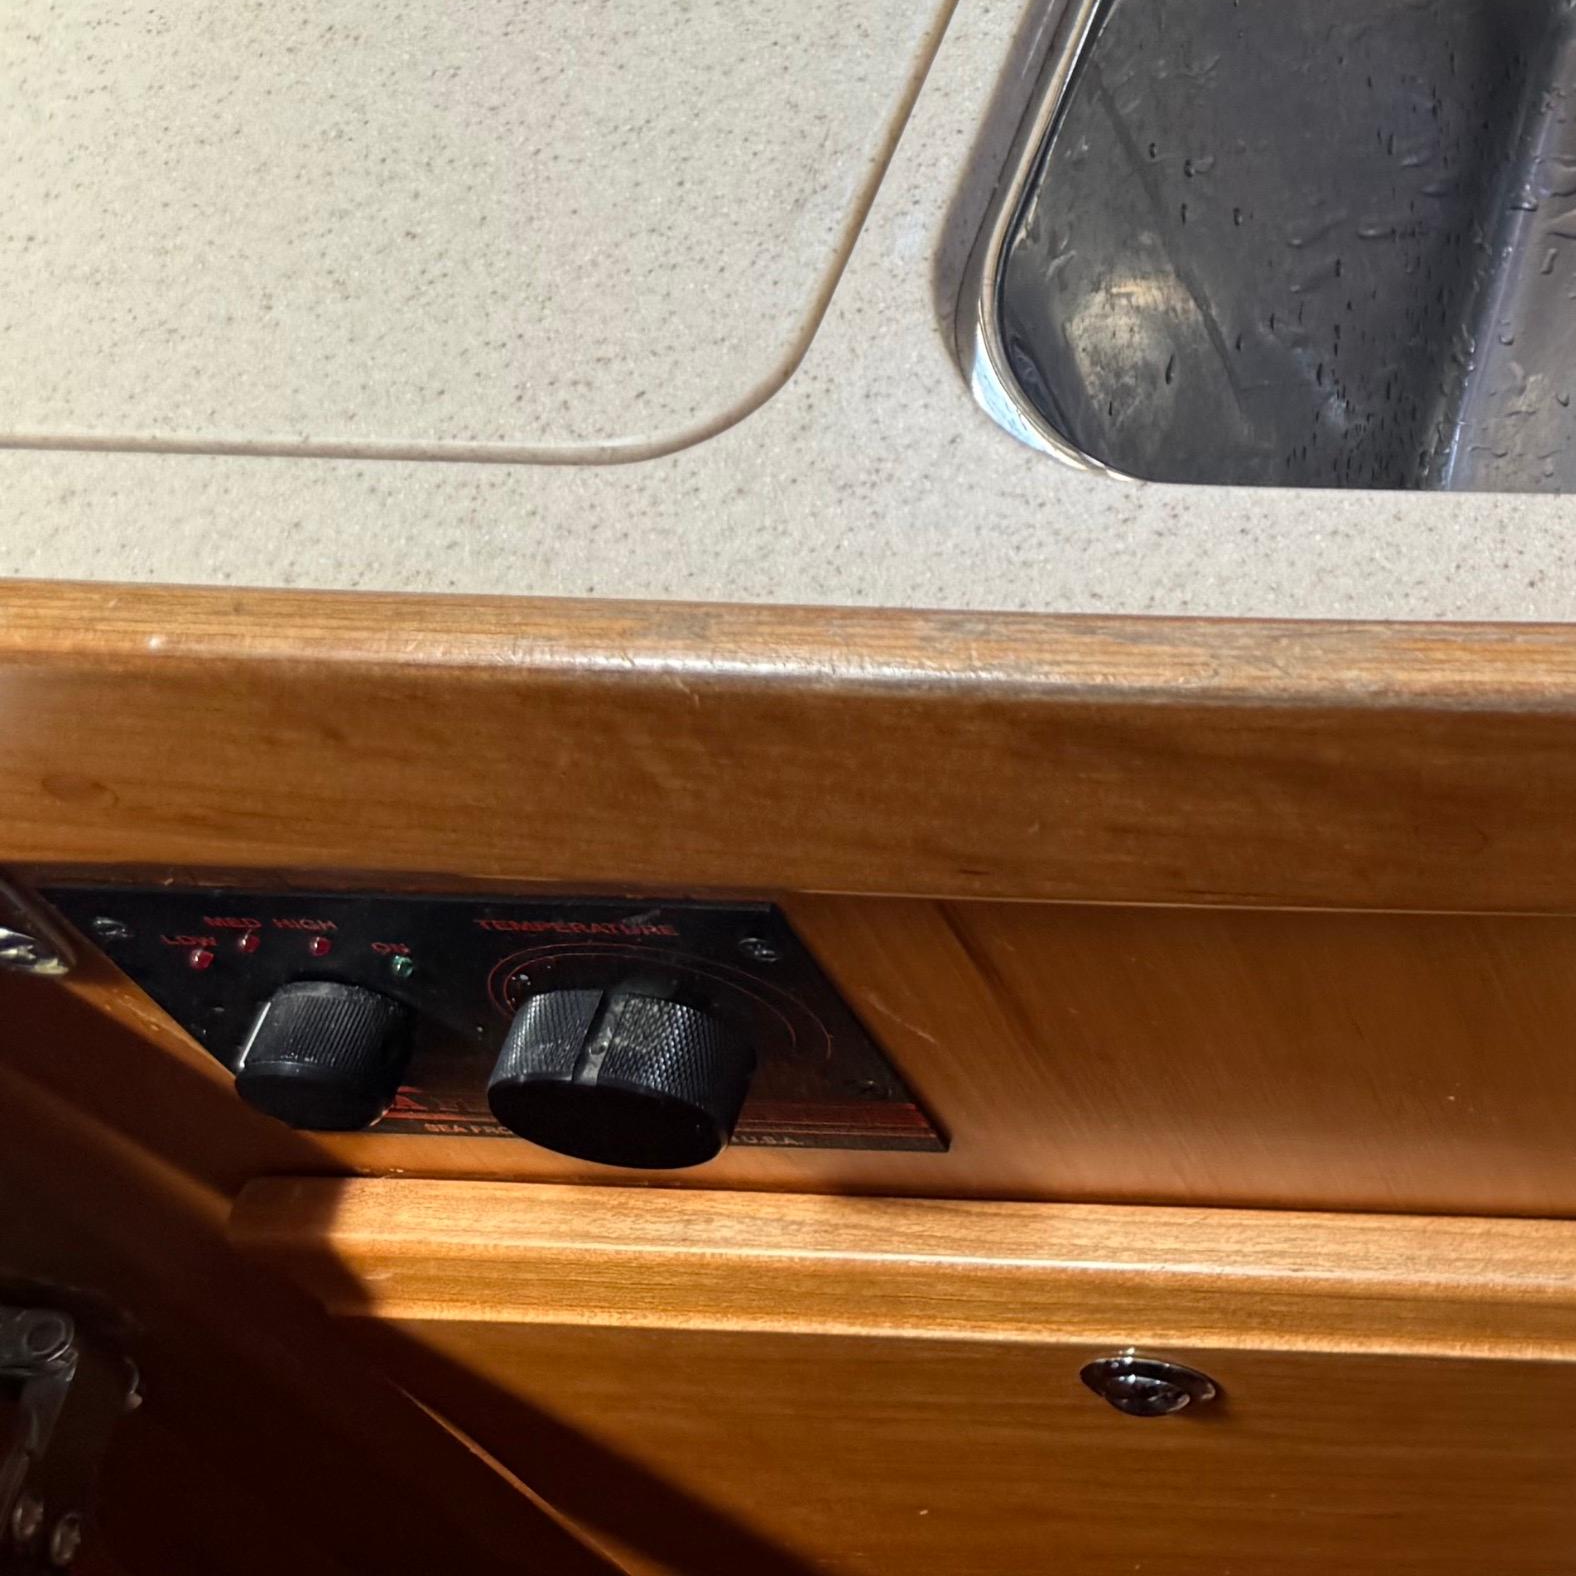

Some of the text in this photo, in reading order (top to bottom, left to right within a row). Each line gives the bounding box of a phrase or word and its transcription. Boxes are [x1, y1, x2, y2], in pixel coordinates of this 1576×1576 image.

[203, 915, 262, 930] MED
[272, 918, 337, 931] HIGH
[473, 919, 680, 936] TEMPERATURE
[160, 934, 217, 947] LOW
